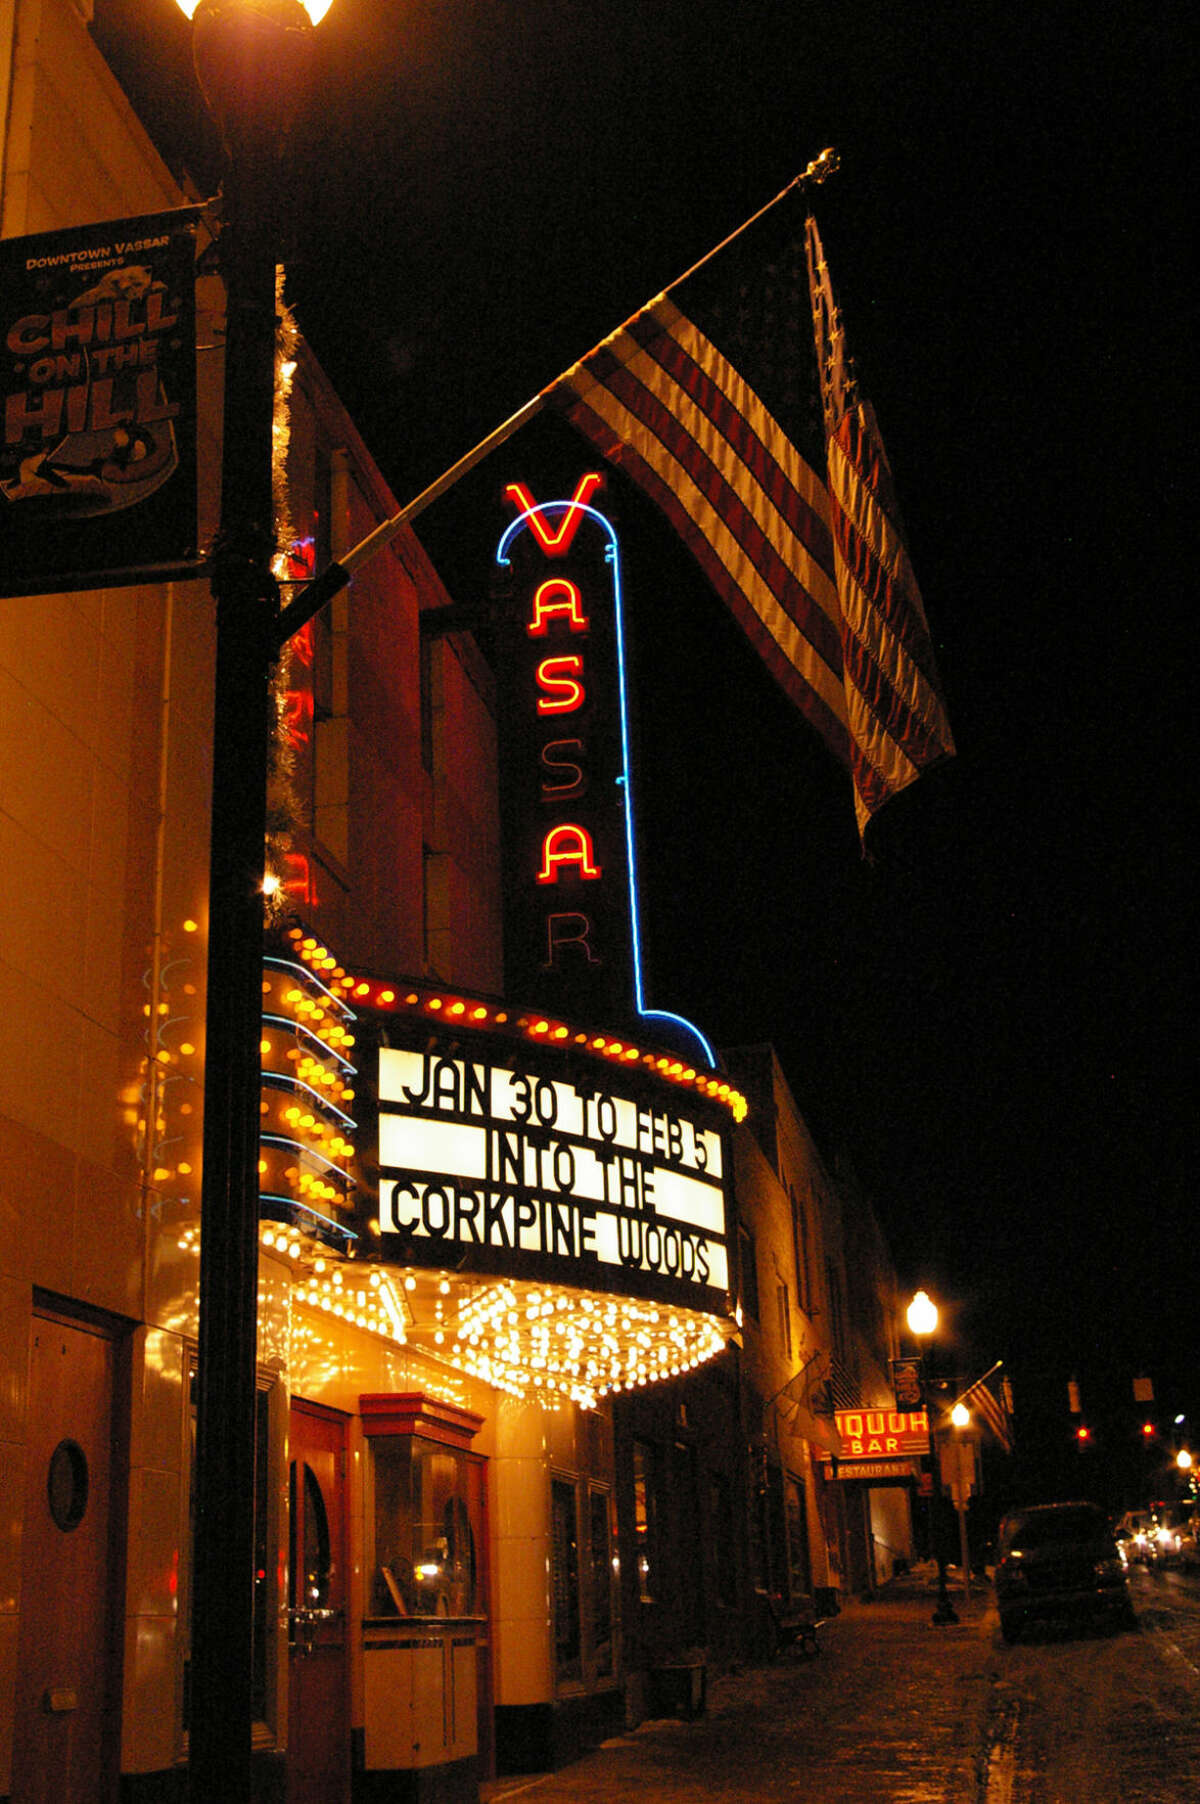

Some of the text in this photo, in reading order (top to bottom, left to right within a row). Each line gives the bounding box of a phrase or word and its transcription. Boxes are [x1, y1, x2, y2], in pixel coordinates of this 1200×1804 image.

[25, 234, 170, 271] DOWNTOWN VASSAR
[69, 257, 125, 273] PRESENTS
[7, 292, 178, 354] CHILL
[29, 338, 159, 383] ON THE
[4, 371, 181, 443] HILL
[503, 470, 603, 968] VASSAR
[402, 1052, 707, 1171] JAN 30 TO FEB 5
[486, 1129, 656, 1215] INTO THE
[391, 1181, 711, 1284] CORKPINE WOODS
[851, 1438, 898, 1454] BAR
